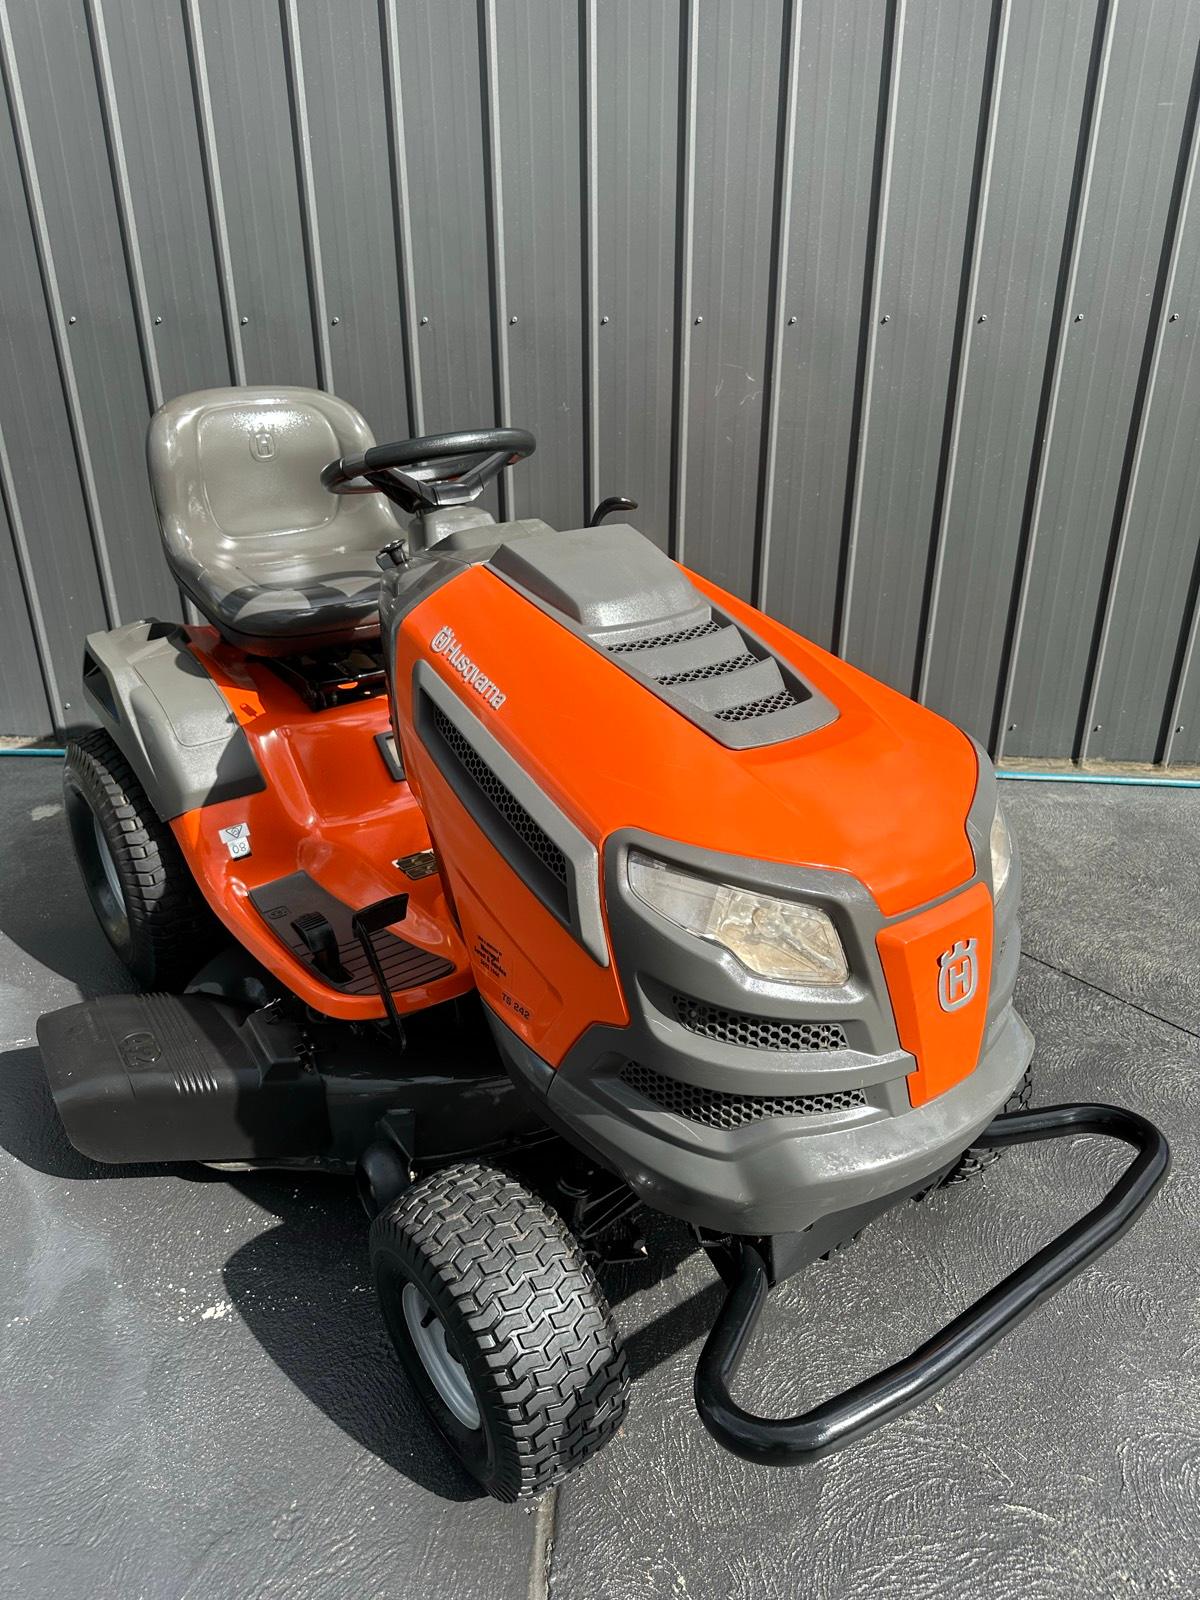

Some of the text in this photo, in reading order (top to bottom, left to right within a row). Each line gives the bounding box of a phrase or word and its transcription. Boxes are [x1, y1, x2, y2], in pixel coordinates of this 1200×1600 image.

[442, 638, 507, 710] Husqvarna
[501, 992, 530, 1020] TS 242
